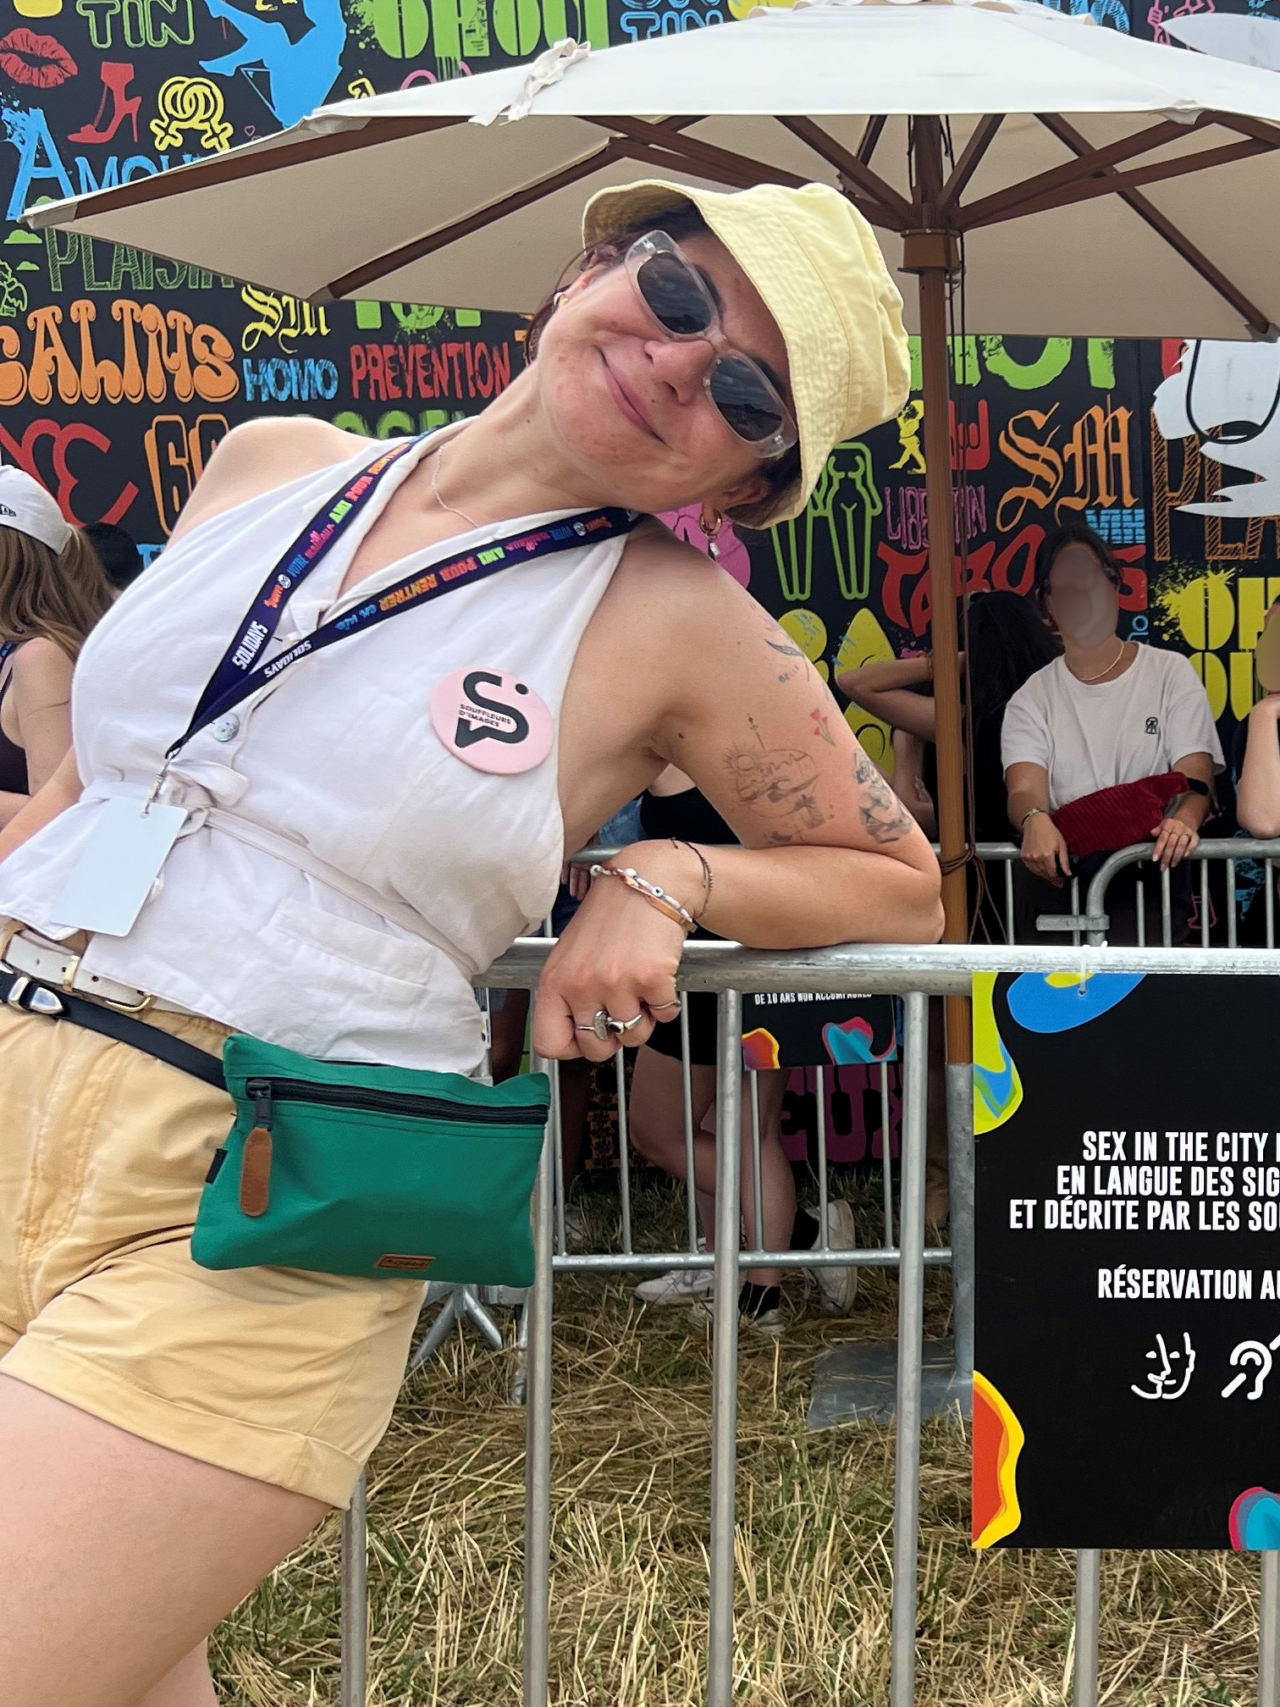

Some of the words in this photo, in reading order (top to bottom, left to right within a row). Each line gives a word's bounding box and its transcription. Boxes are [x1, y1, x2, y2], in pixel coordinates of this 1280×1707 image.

[242, 358, 338, 402] HOMO
[350, 341, 512, 401] PREVENTION
[328, 500, 353, 524] AMI
[345, 475, 374, 502] POUR
[439, 556, 477, 582] POUR
[379, 573, 438, 611] RENTRER
[231, 620, 269, 670] SOLIDAYS
[263, 640, 312, 678] SOLIDAYS
[460, 703, 512, 725] SOUFFLEURS
[1083, 1131, 1126, 1161] SEX
[1135, 1132, 1157, 1161] IN
[1165, 1132, 1208, 1162] THE
[1217, 1132, 1268, 1162] CITY
[1057, 1167, 1086, 1195] EN
[1093, 1167, 1182, 1196] LANGUE
[1190, 1168, 1235, 1196] DES
[1010, 1200, 1037, 1229] ET
[1045, 1196, 1139, 1230] DÉCRITE
[1147, 1201, 1191, 1230] PAR
[1199, 1202, 1240, 1231] LES
[1099, 1264, 1252, 1300] RÉSERVATION
